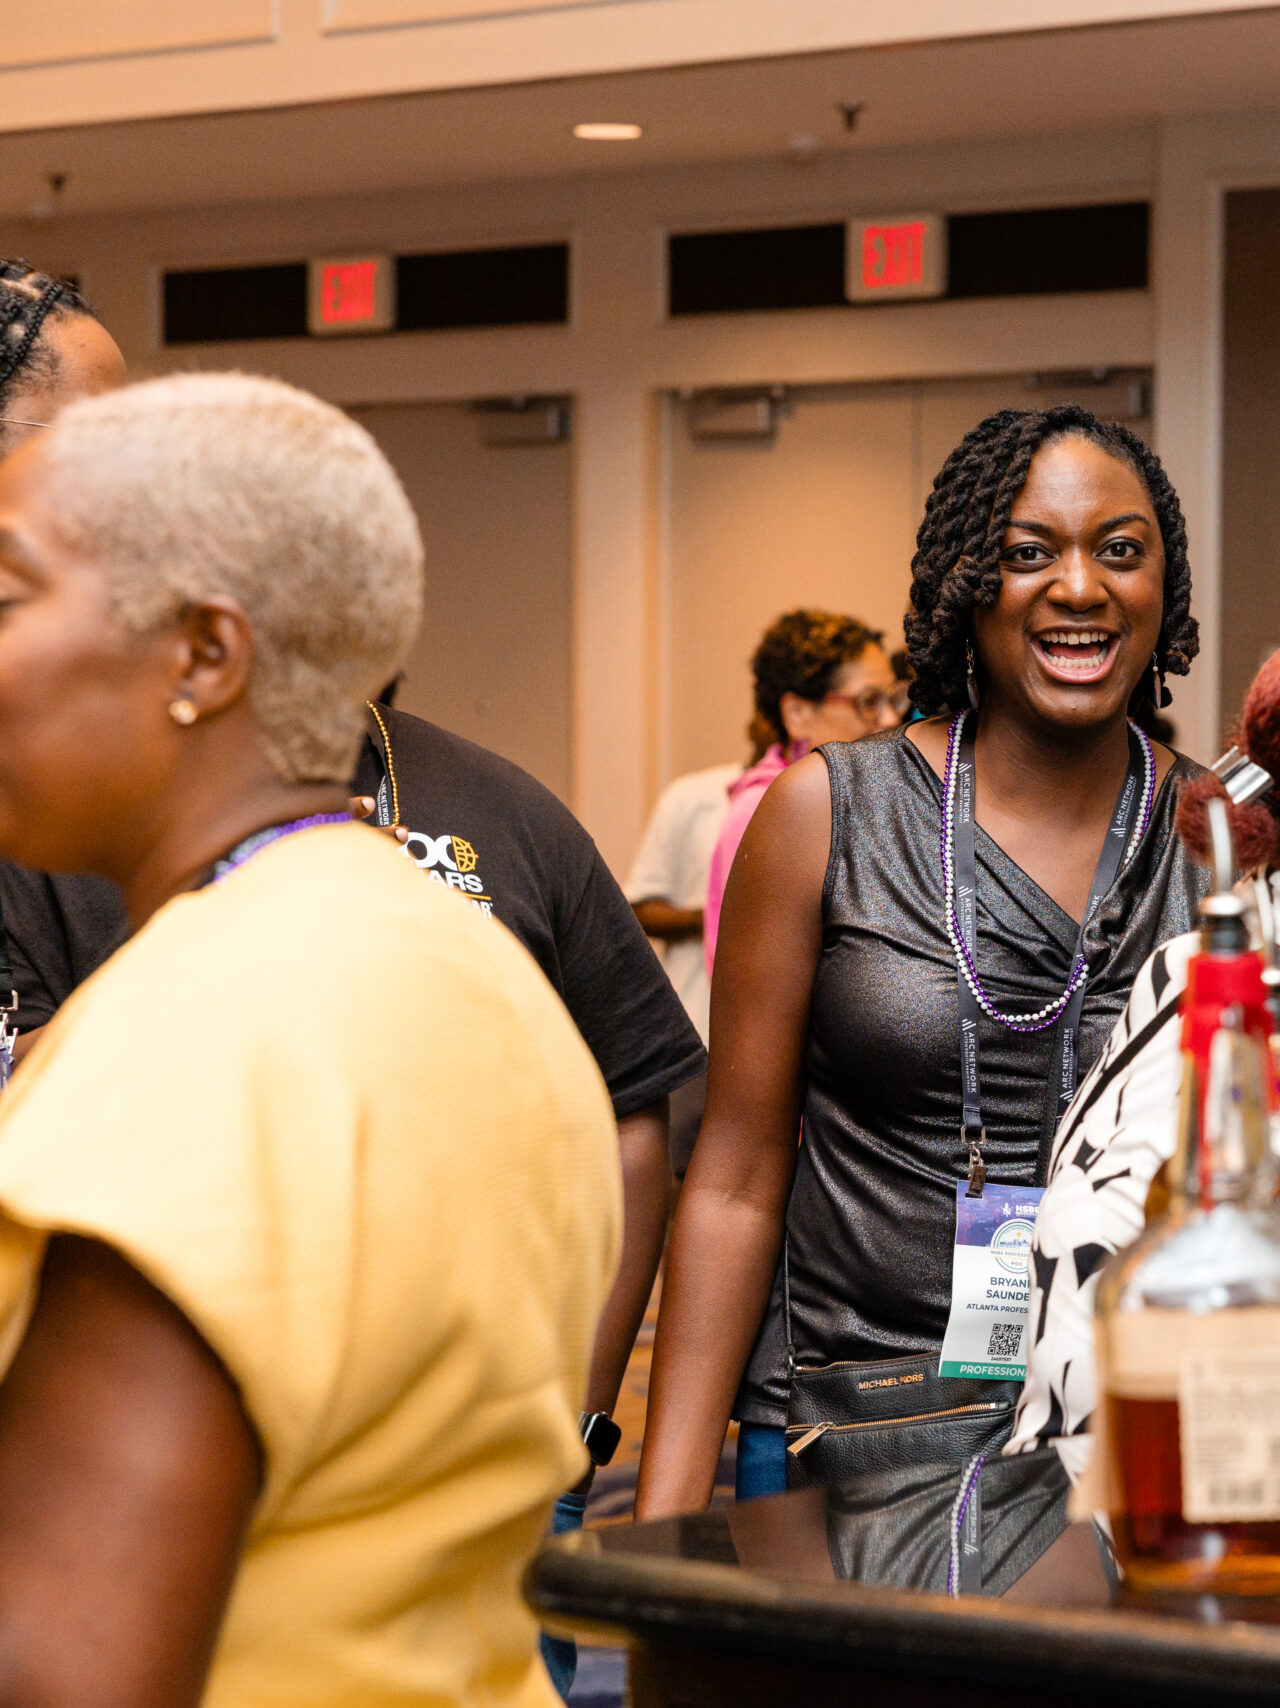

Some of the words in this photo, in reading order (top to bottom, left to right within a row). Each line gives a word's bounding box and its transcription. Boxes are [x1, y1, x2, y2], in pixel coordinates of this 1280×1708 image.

[862, 221, 927, 288] EXIT
[963, 773, 971, 788] ARC
[1115, 810, 1125, 826] ARC
[1120, 775, 1135, 810] NETWORK
[428, 869, 484, 893] ARS
[964, 897, 972, 914] ARC
[964, 914, 972, 953] NETWORK
[968, 1032, 976, 1050] ARC
[1062, 1028, 1070, 1070] NETWORK
[969, 1051, 977, 1093] NETWORK
[966, 1303, 999, 1312] ATLANTA
[858, 1377, 899, 1391] MICHAEL
[900, 1373, 925, 1385] KORS
